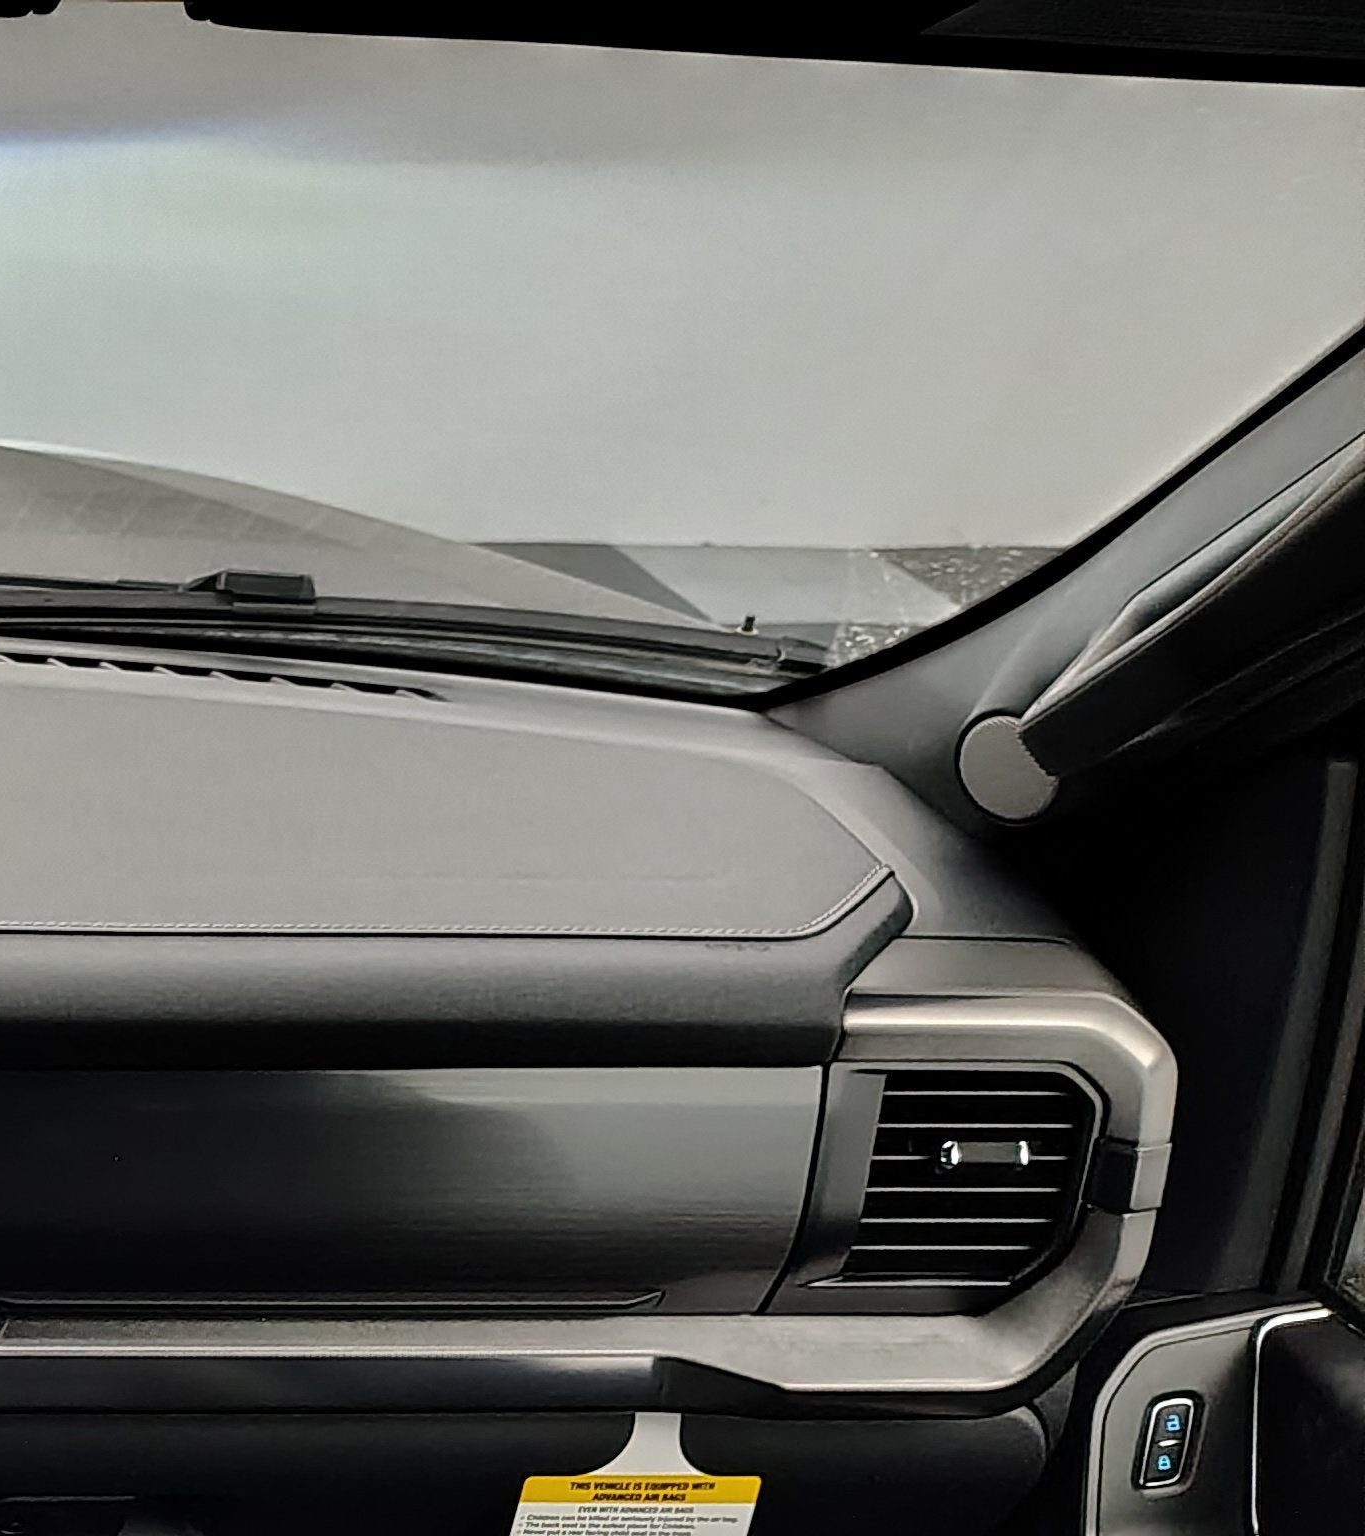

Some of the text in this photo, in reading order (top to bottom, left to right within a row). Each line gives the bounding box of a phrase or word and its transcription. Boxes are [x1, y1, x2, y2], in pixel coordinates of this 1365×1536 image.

[571, 1482, 591, 1490] THIS
[594, 1482, 631, 1490] VEHICLE
[633, 1482, 642, 1490] IS
[645, 1482, 689, 1490] EQUIPPED
